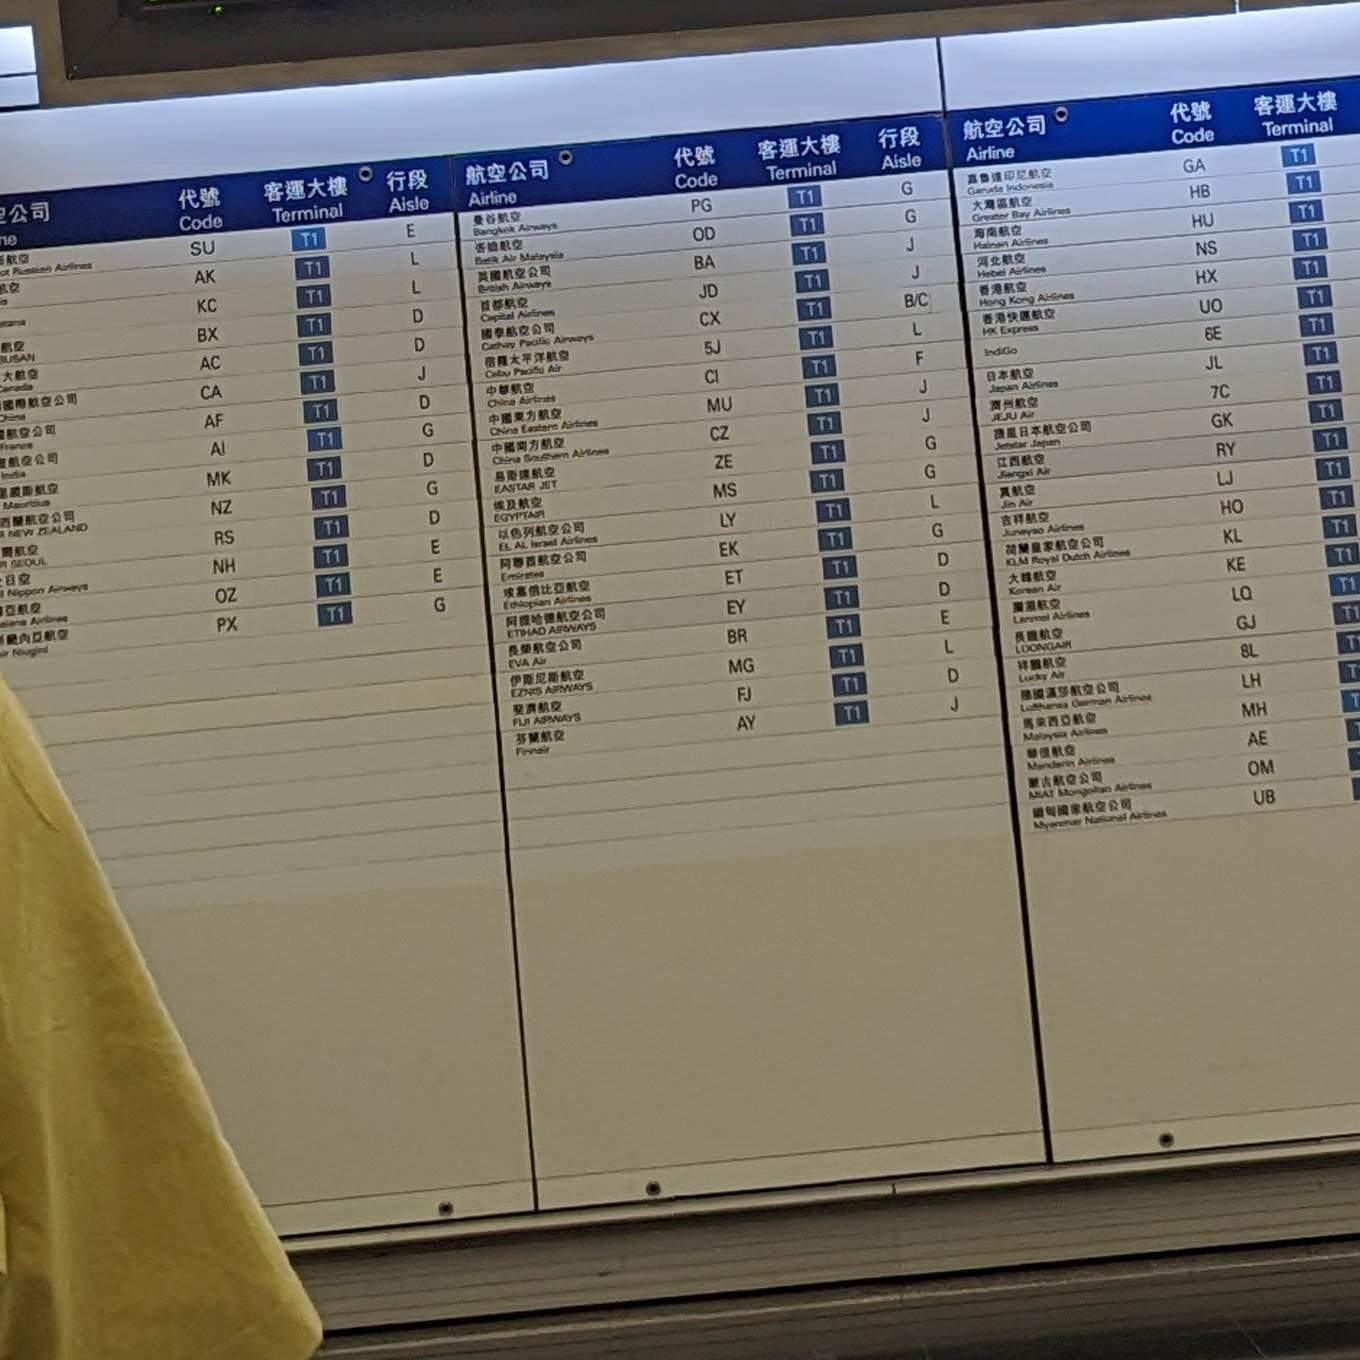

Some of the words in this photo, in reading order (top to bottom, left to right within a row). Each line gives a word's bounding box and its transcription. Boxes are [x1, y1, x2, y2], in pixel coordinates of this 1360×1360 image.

[963, 114, 1046, 140] 航空公司
[1170, 100, 1212, 123] 代號
[1254, 90, 1337, 116] 客運大樓
[966, 145, 1015, 161] Airline
[1171, 126, 1214, 144] Code
[1261, 116, 1333, 136] Terminal
[178, 186, 220, 209] 代號
[263, 175, 348, 202] 客運大樓
[386, 169, 428, 192] 行段
[795, 189, 813, 204] T1
[1189, 183, 1211, 199] HB
[179, 213, 223, 231] Code
[271, 202, 343, 223] Terminal
[389, 195, 429, 213] Aisle
[190, 240, 215, 256] SU
[1195, 269, 1218, 285] HX
[699, 310, 721, 327] CX
[904, 291, 928, 308] B/C
[706, 396, 732, 412] MU
[1215, 441, 1235, 457] RY
[206, 470, 231, 486] MK
[213, 558, 236, 574] NH
